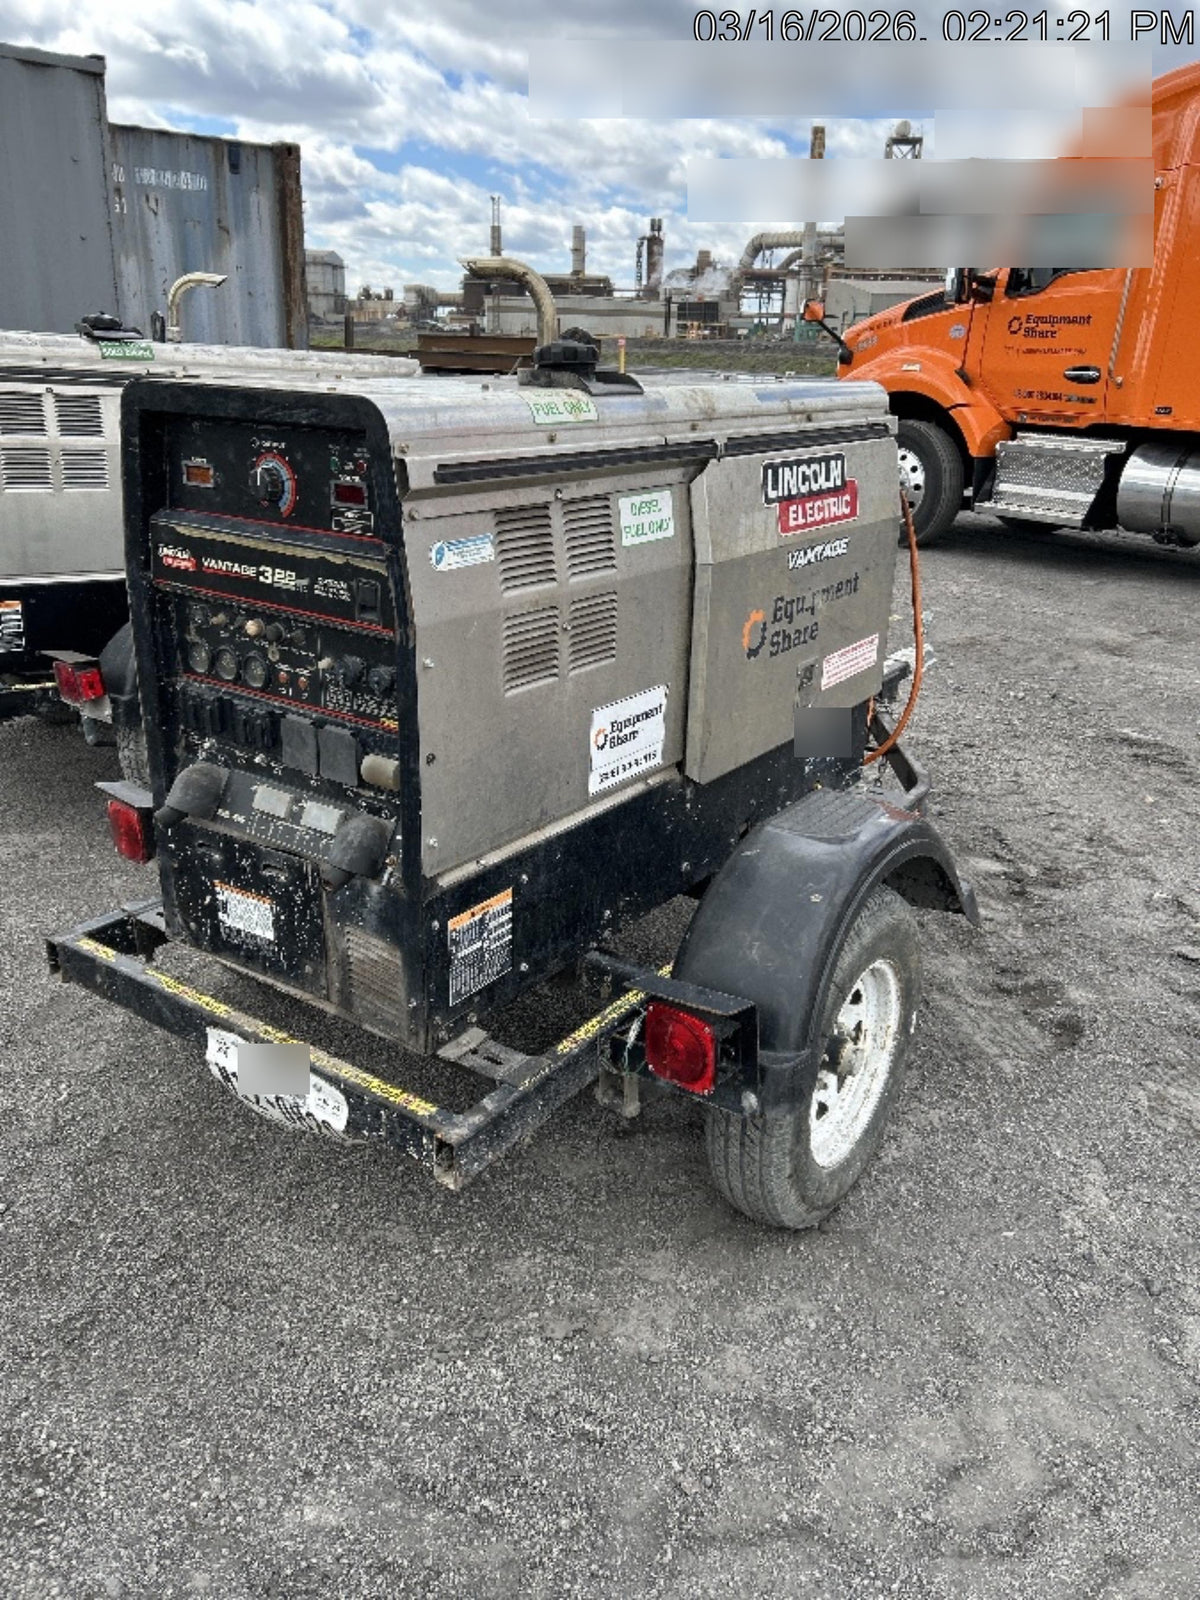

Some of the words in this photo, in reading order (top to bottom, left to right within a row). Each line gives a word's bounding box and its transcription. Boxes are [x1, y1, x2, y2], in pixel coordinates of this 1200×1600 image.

[1023, 326, 1057, 338] Share
[1025, 313, 1092, 327] Equipment
[533, 402, 564, 416] FUEL
[563, 400, 591, 415] ONLY
[767, 460, 841, 499] LINCOLN
[788, 494, 850, 527] ELECTRIC
[623, 522, 648, 539] FUEL
[787, 537, 851, 570] VANTAGE
[202, 557, 257, 576] VANTAGE
[769, 621, 819, 657] Share
[609, 703, 663, 735] Equipment
